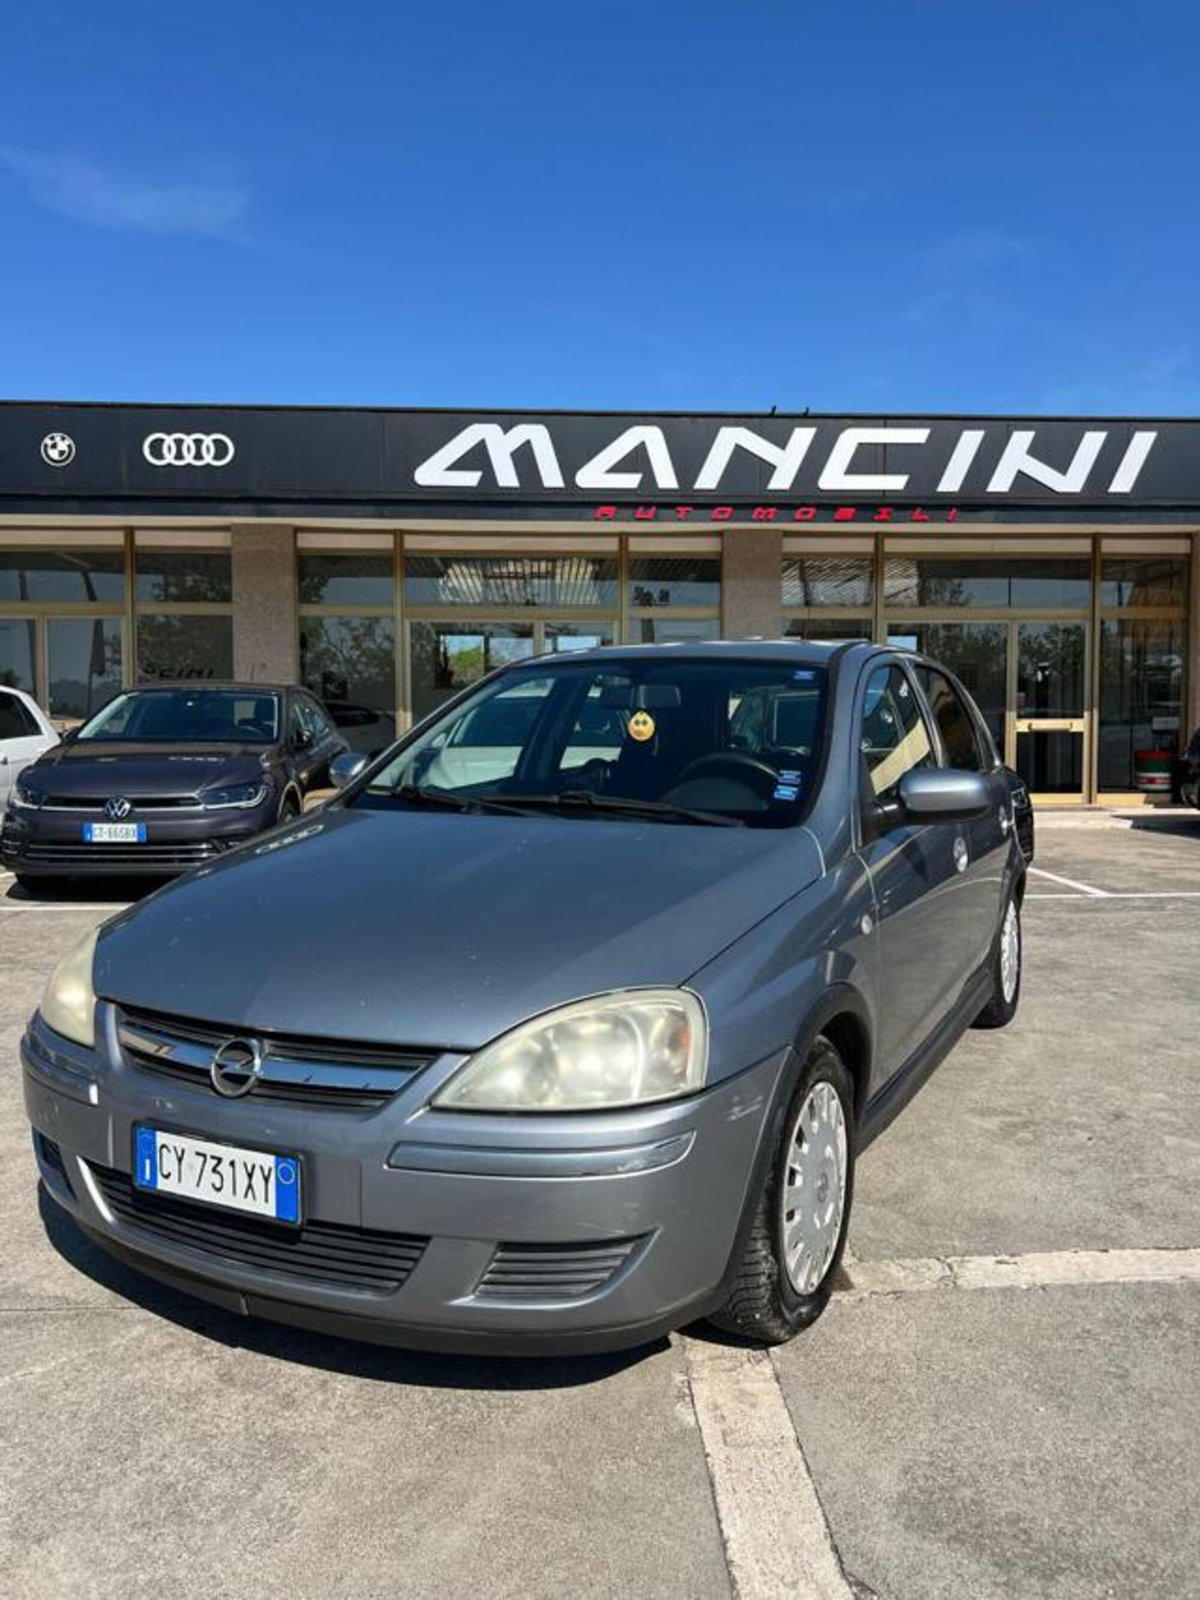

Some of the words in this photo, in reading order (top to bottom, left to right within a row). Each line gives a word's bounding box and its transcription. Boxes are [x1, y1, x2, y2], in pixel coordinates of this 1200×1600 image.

[414, 423, 1157, 493] MANCINI
[594, 506, 960, 521] AUTOMOBILI
[159, 1143, 185, 1183] CY
[195, 1151, 273, 1203] 731XY
